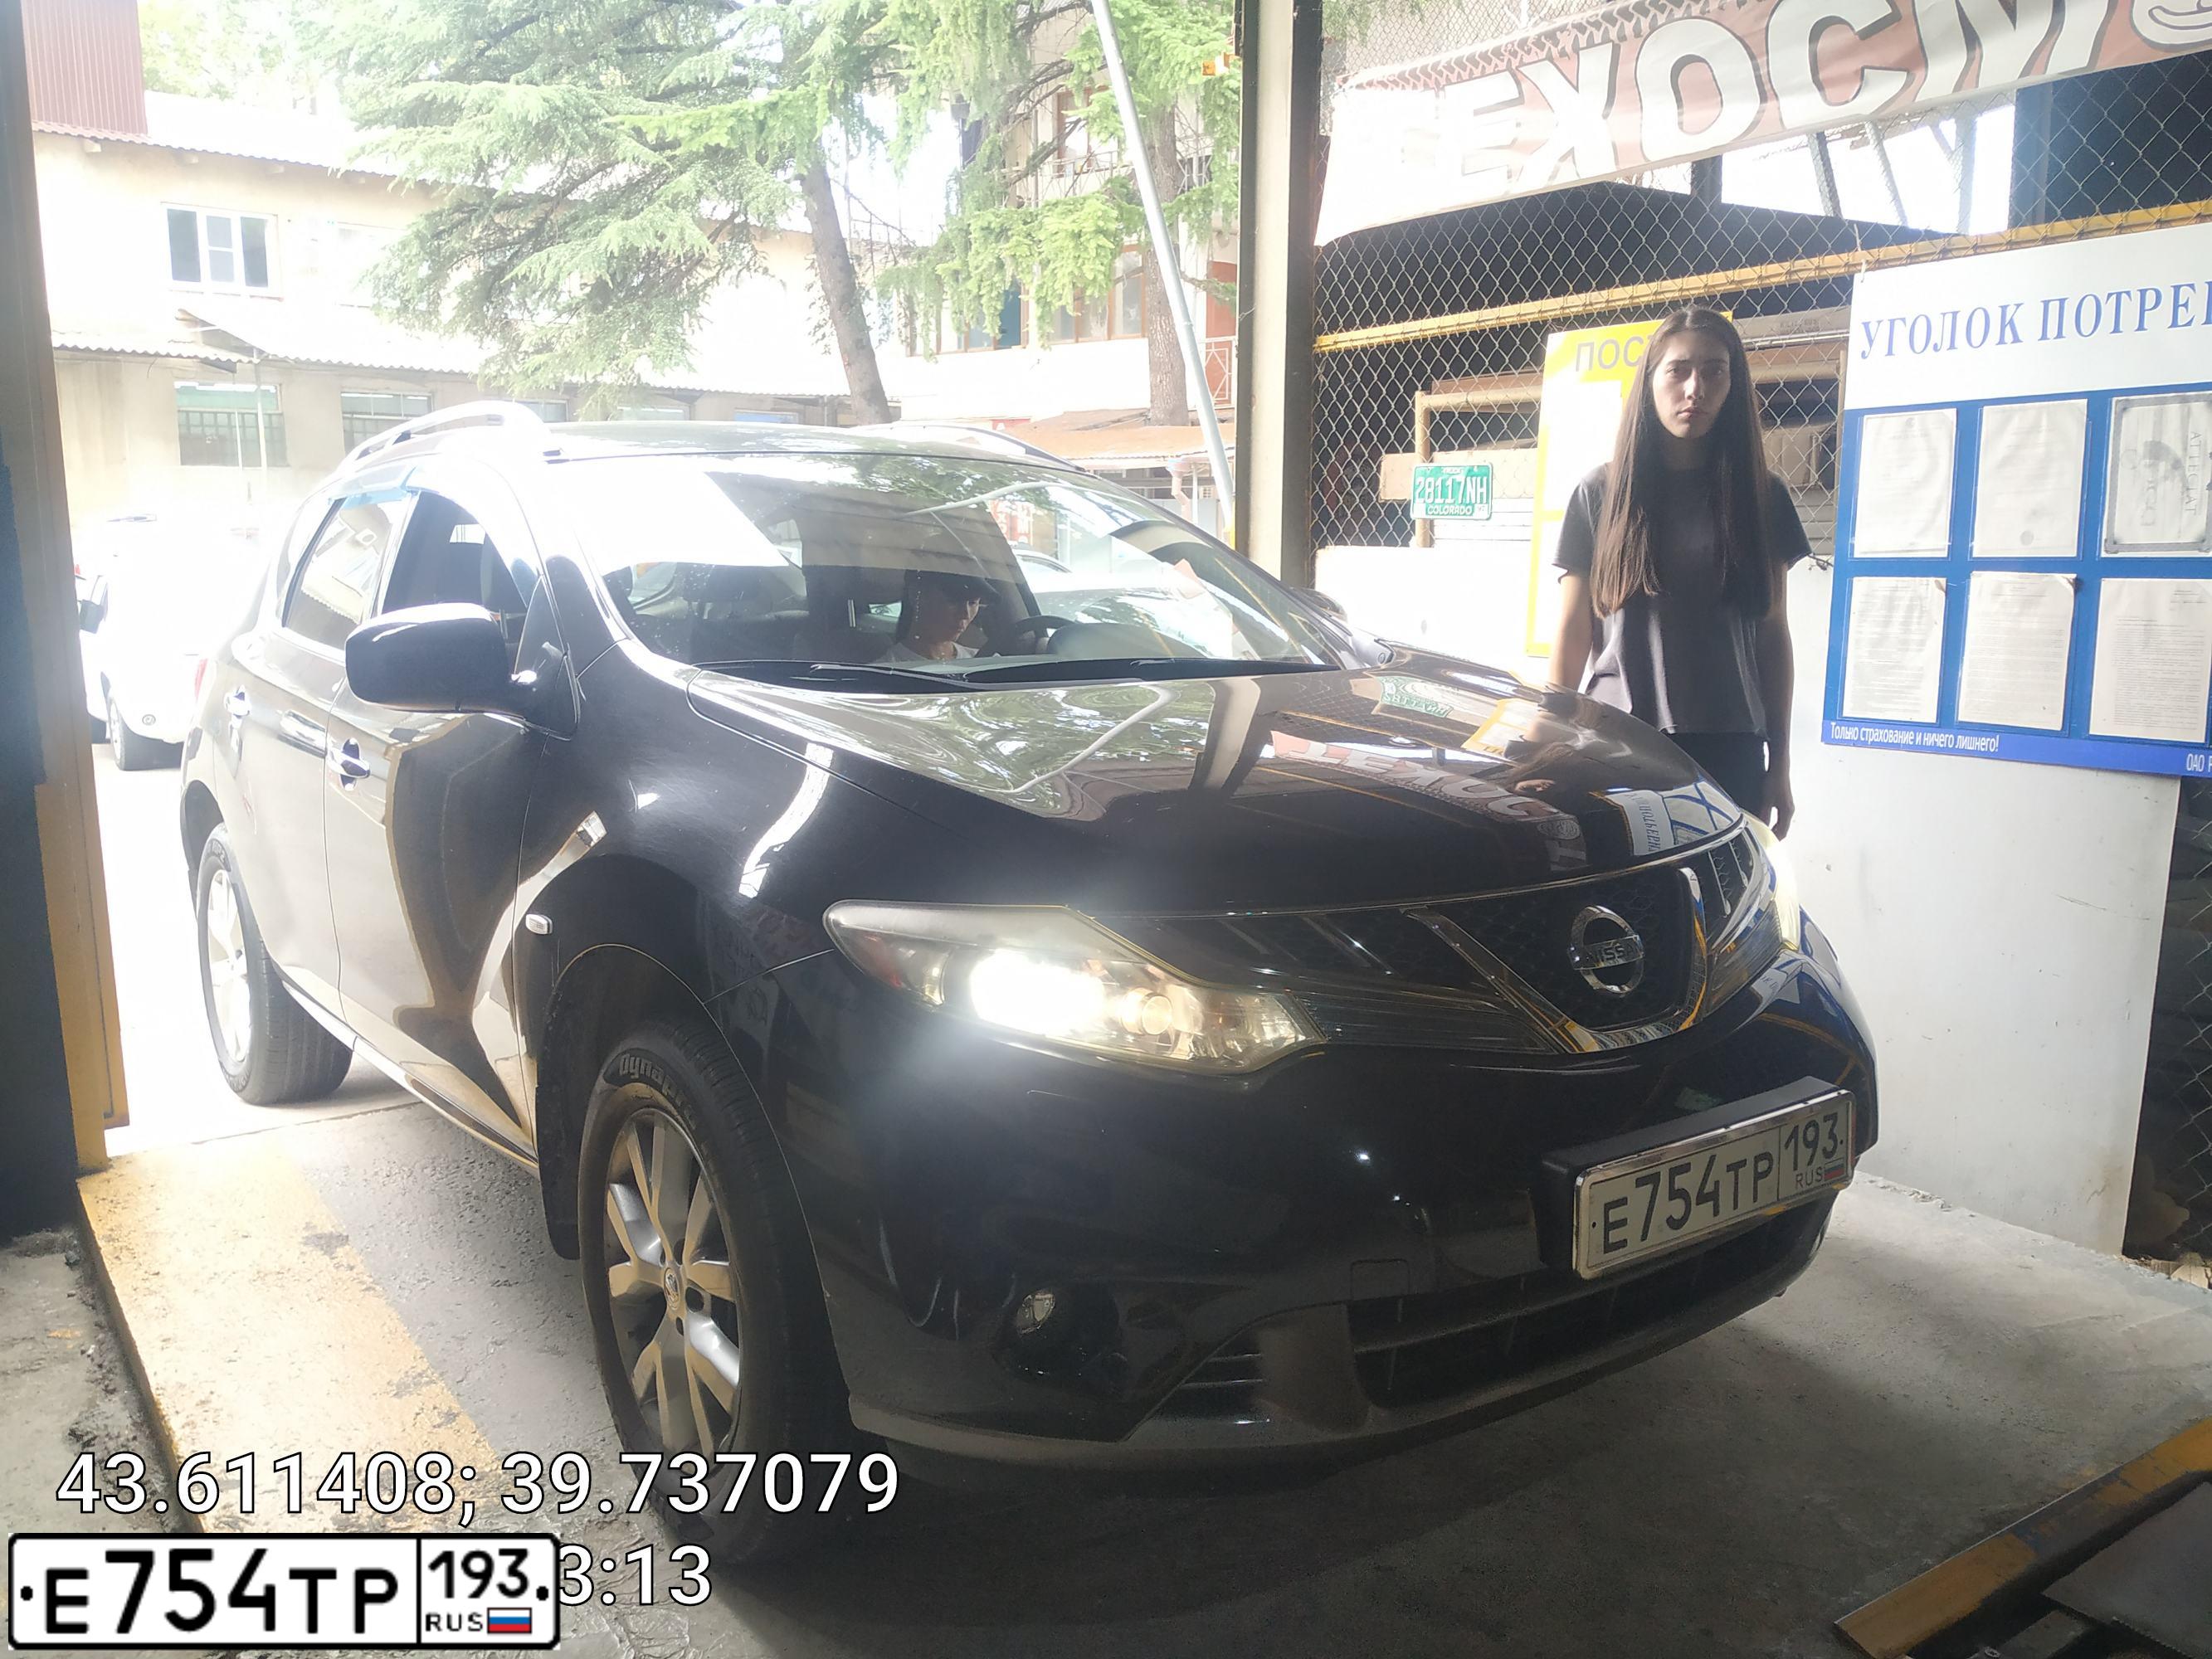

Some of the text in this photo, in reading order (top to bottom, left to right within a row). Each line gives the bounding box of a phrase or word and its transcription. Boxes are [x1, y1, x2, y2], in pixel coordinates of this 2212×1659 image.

[1860, 280, 2212, 360] УГОЛОК ПОТРЕ
[1576, 334, 1653, 372] ПОС
[1415, 476, 1488, 504] 28117NH
[1426, 504, 1473, 516] COLORADO
[1830, 722, 2000, 752] Только страхование и ничего лишнего!
[2186, 753, 2205, 772] ОАО
[1602, 1112, 1839, 1255] Е754ТР 193
[1795, 1165, 1824, 1190] RUS
